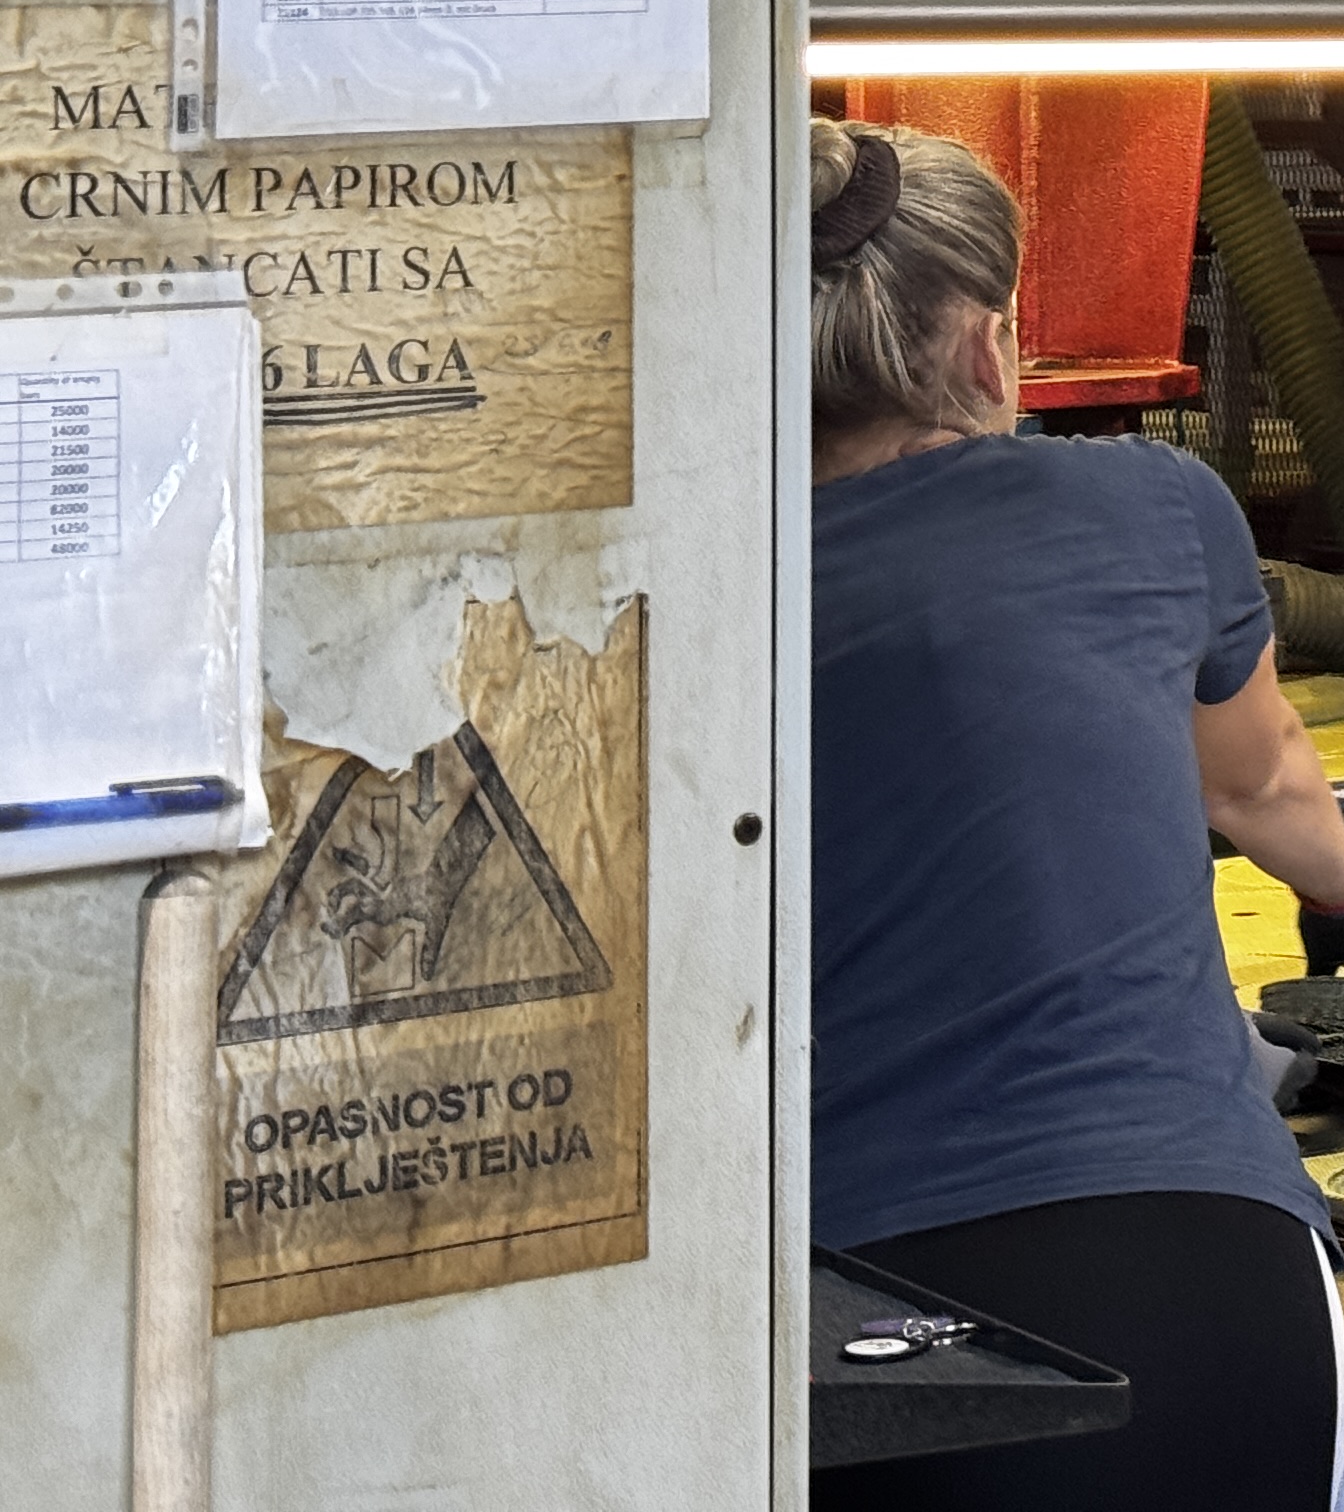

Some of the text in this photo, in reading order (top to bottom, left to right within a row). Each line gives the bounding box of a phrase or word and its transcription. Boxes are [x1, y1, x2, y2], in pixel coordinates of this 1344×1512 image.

[20, 160, 518, 220] CRNIM PAPIROM
[402, 244, 475, 292] SA
[303, 337, 475, 389] LAGA
[244, 1068, 574, 1154] OPASNOST OD
[223, 1122, 594, 1220] PRIKLJEŠTENJA
